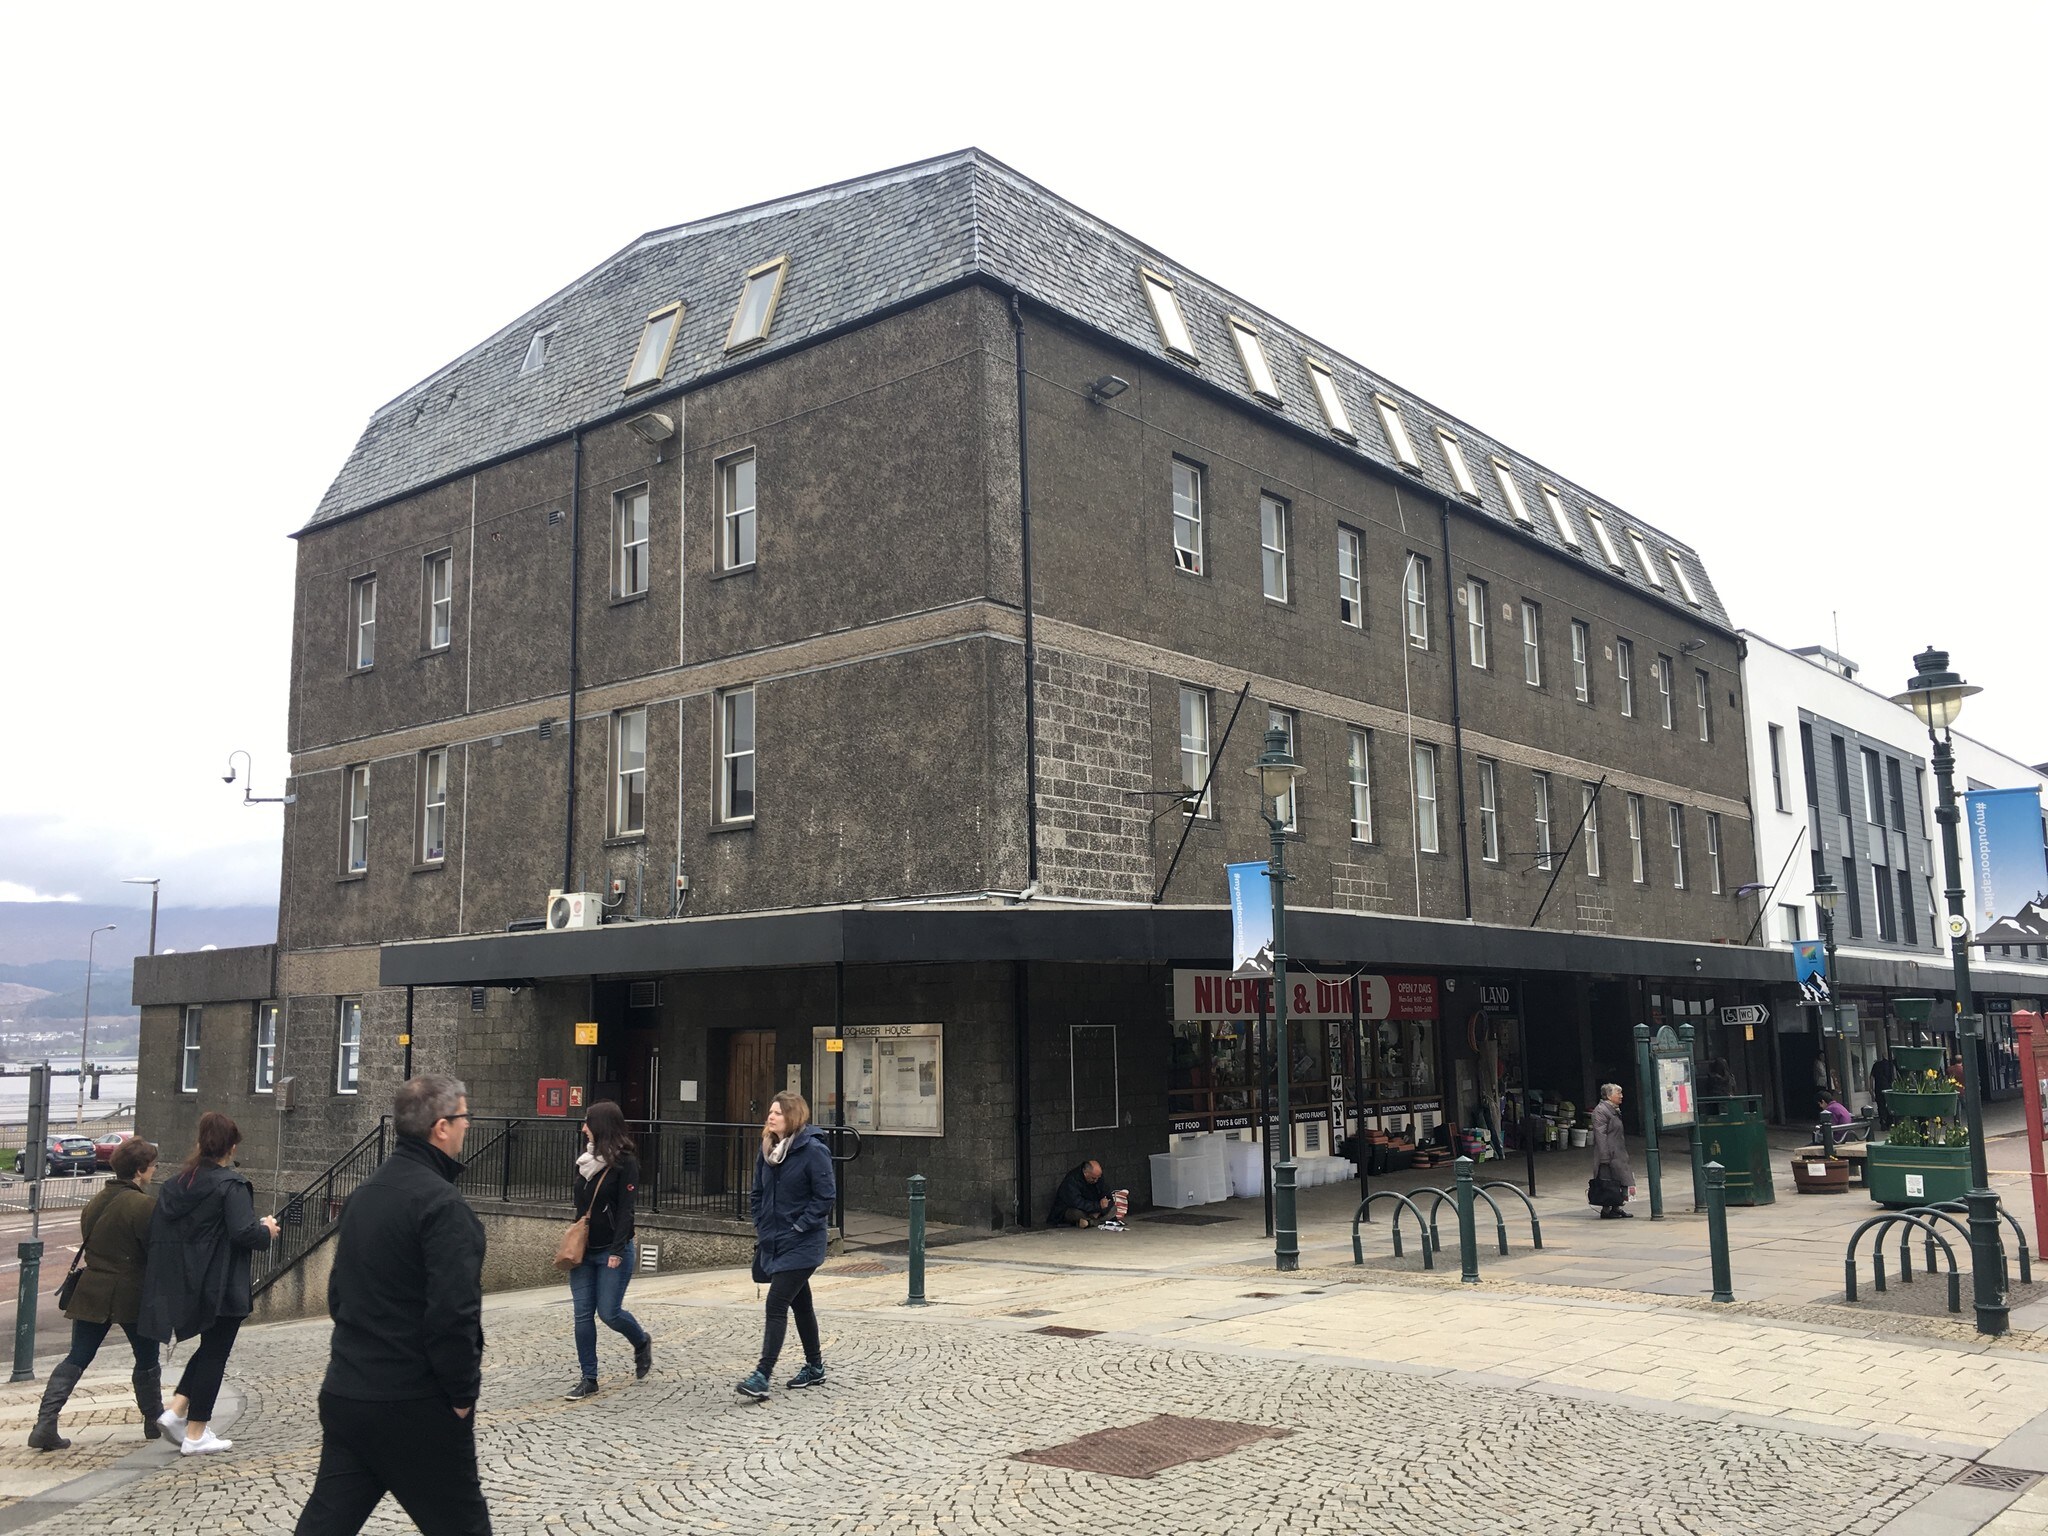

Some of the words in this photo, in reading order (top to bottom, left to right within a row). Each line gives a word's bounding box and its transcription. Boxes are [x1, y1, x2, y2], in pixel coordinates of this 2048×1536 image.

[1975, 802, 1996, 911] #myoutdoorcapital
[1397, 983, 1413, 993] OPEN
[1413, 983, 1418, 993] 7
[1418, 983, 1432, 993] DAYS
[1194, 975, 1288, 1014] NICKE
[1294, 984, 1311, 1014] &
[1480, 986, 1510, 1004] ILAND
[1741, 1010, 1752, 1019] WC
[843, 1026, 880, 1036] OCHABER
[885, 1026, 912, 1035] HOUSE
[1382, 1104, 1407, 1113] ELECTRONICS
[1295, 1111, 1310, 1119] PHOTO
[1311, 1110, 1327, 1118] FRAMES
[1175, 1122, 1185, 1130] PET
[1185, 1121, 1200, 1129] FOOD
[1216, 1119, 1229, 1127] TOYS
[1230, 1118, 1234, 1126] &
[1234, 1117, 1248, 1125] GIFTS
